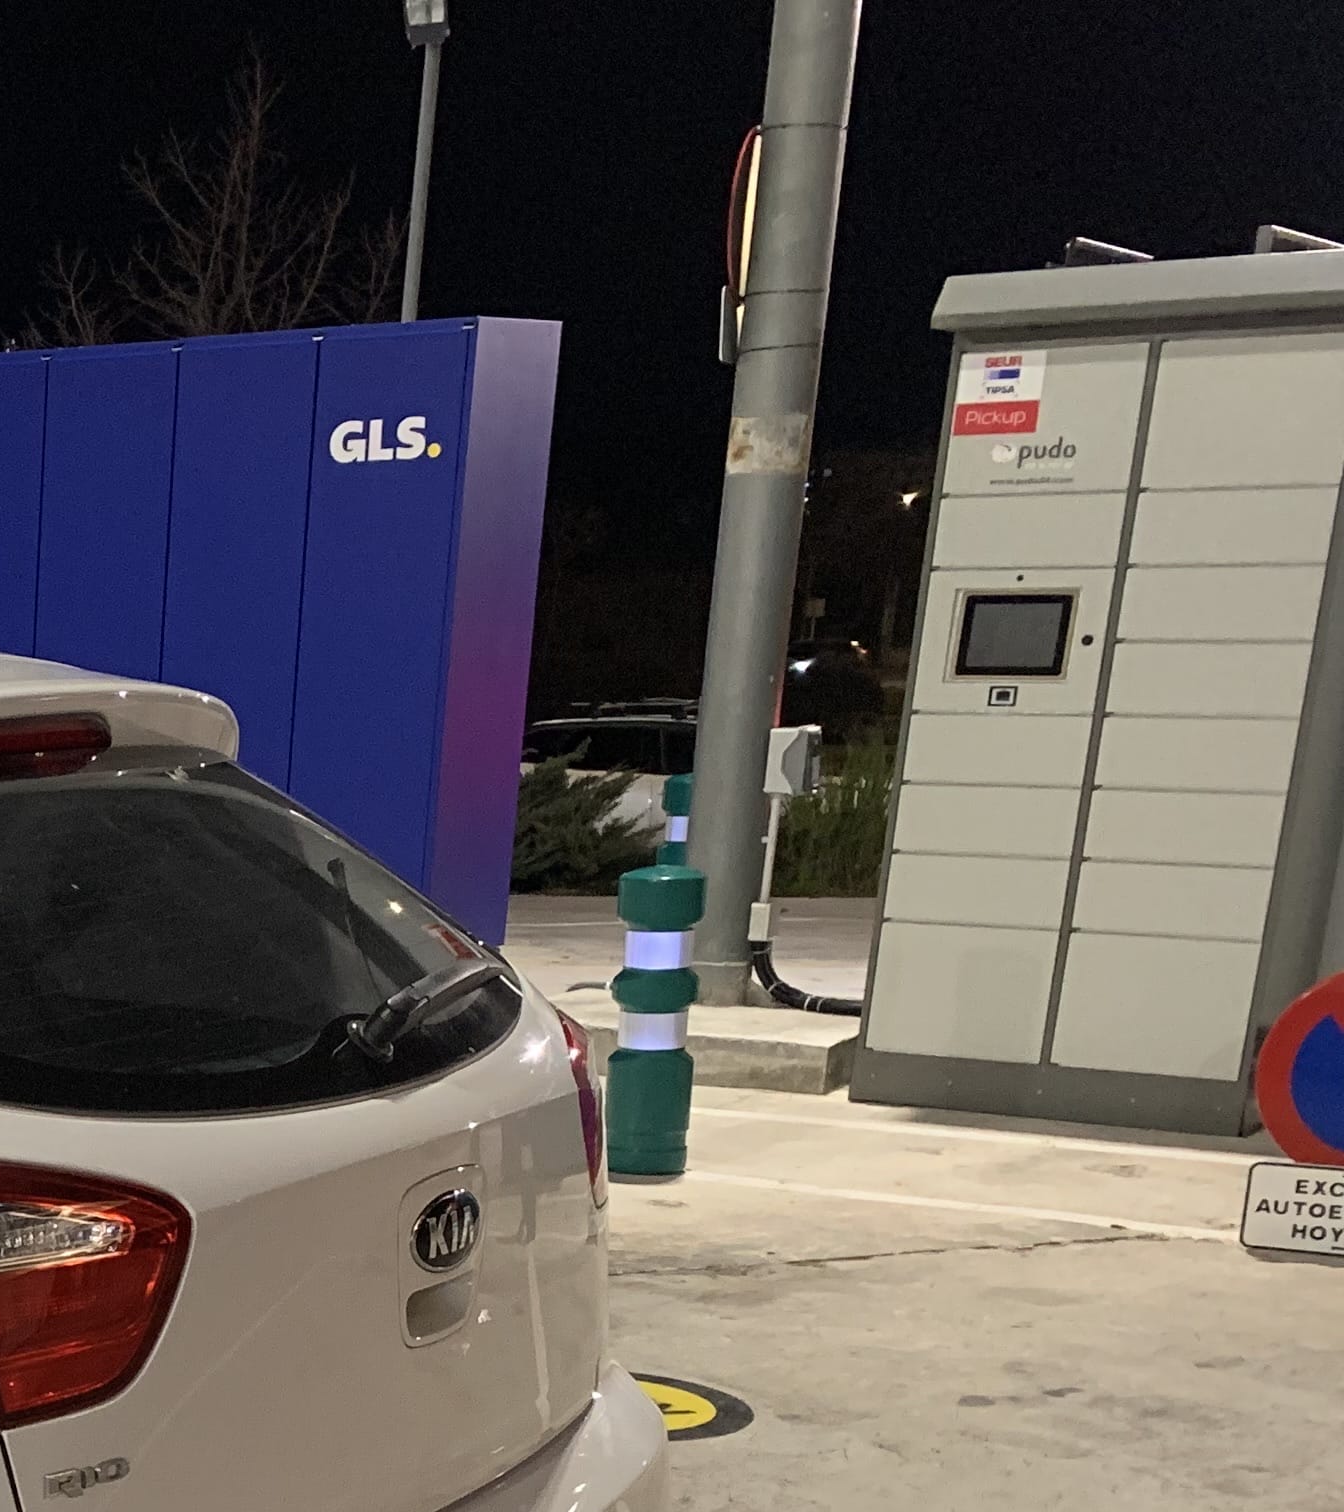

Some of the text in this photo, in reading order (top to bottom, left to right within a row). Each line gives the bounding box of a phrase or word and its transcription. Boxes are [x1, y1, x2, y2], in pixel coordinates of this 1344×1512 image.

[965, 410, 1027, 426] Pickup
[1016, 436, 1077, 469] pudo
[1295, 1179, 1344, 1197] EXC
[1255, 1198, 1343, 1220] AUTOE
[426, 1203, 474, 1260] KIA
[1292, 1223, 1344, 1243] HOY
